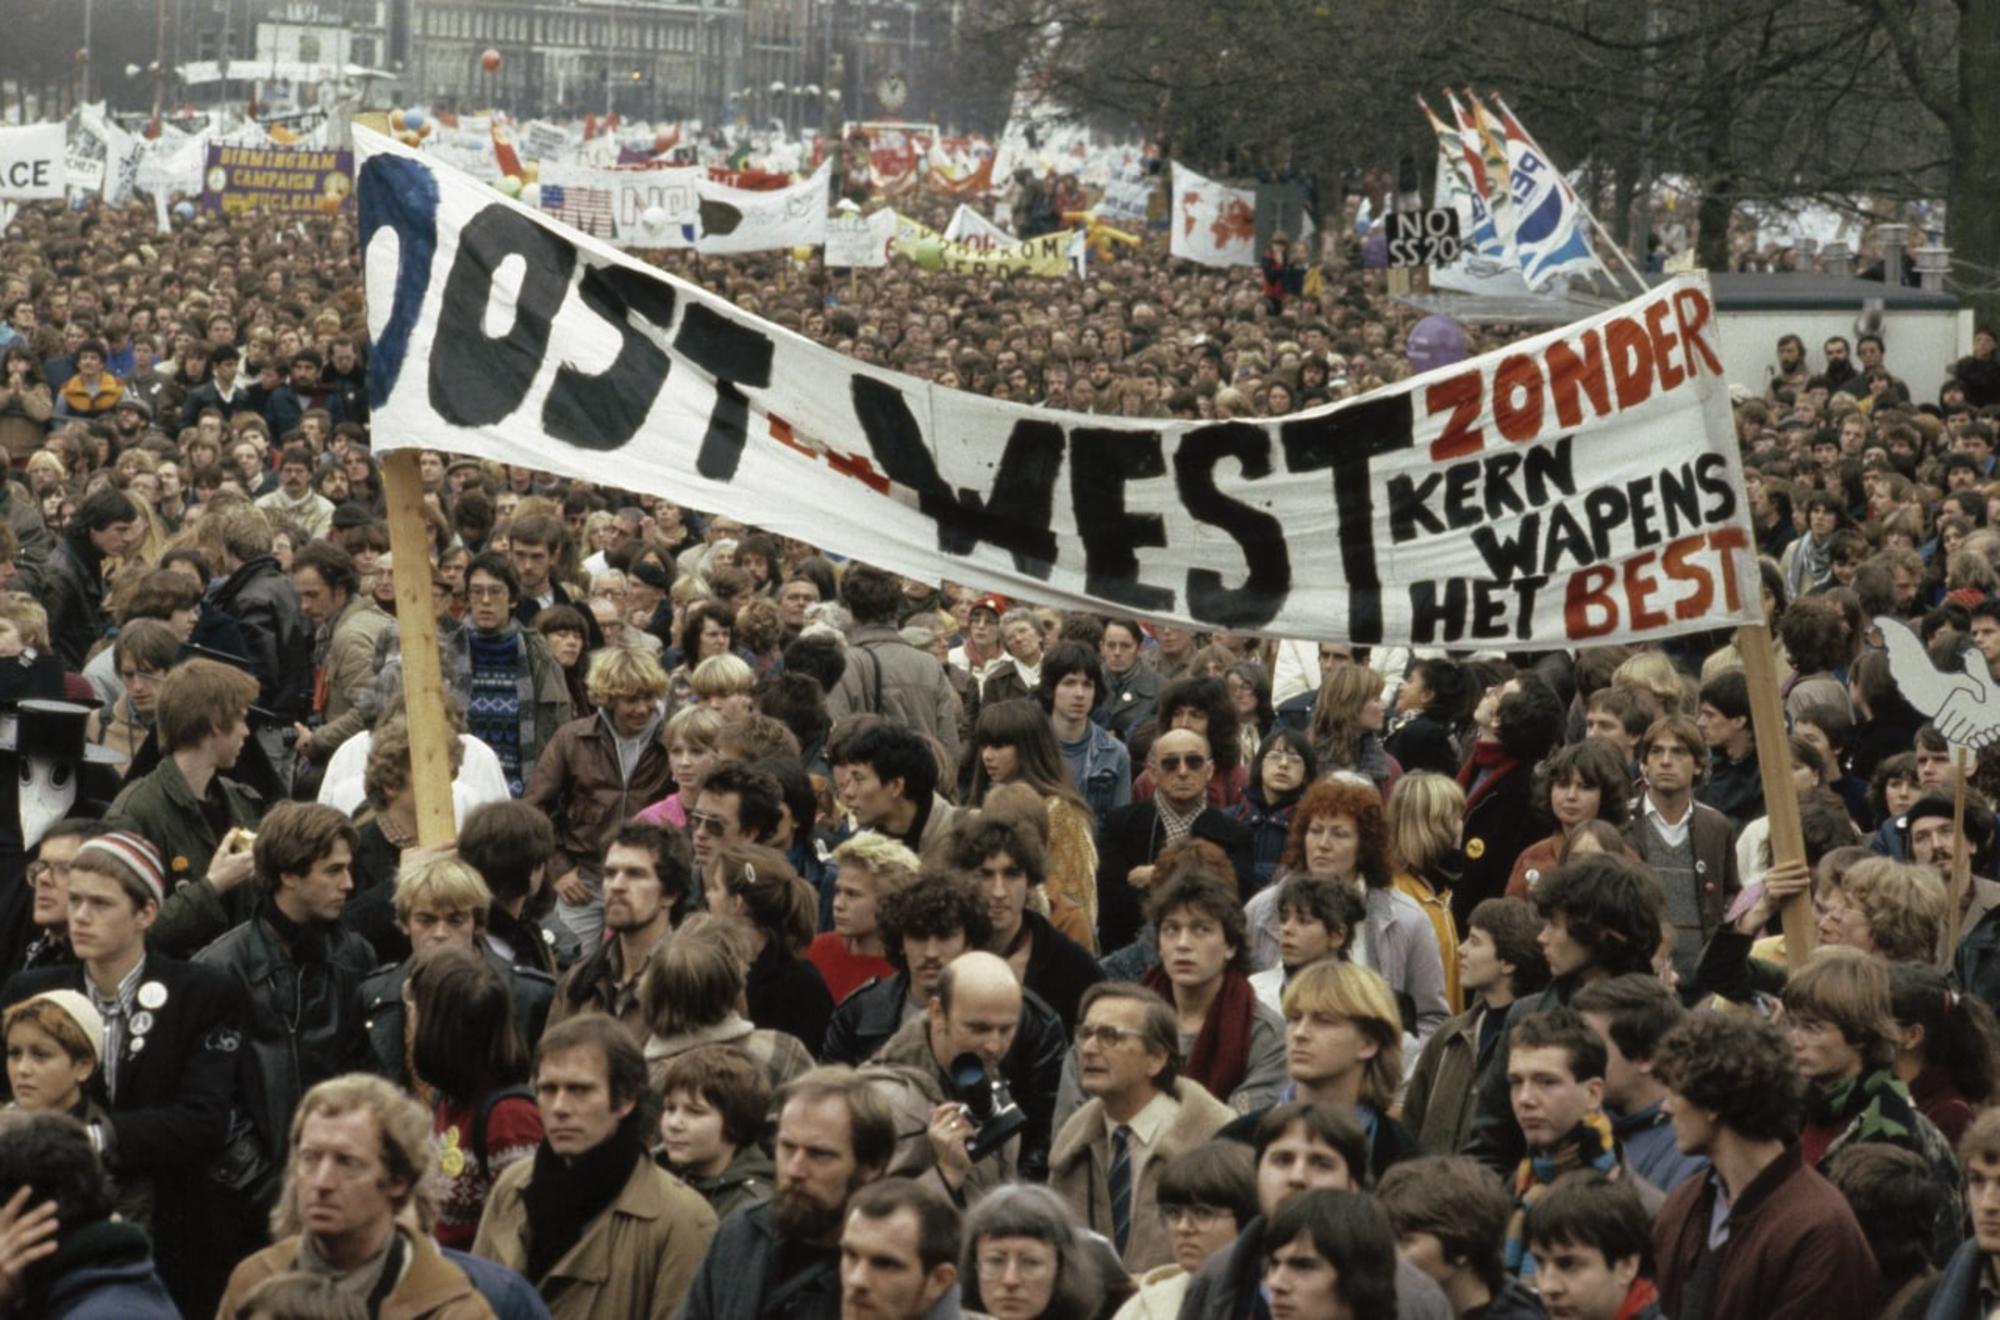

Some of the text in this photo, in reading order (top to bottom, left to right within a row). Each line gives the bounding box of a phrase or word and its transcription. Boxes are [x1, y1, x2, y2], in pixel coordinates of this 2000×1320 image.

[220, 148, 336, 170] BIRMINGHAM
[233, 168, 315, 190] CAMPAIGN
[1397, 209, 1450, 240] NO
[1426, 287, 1724, 461] ZONDER
[1386, 434, 1577, 544] KERN
[1470, 452, 1737, 589] WAPENS
[1409, 526, 1749, 644] HET BEST
